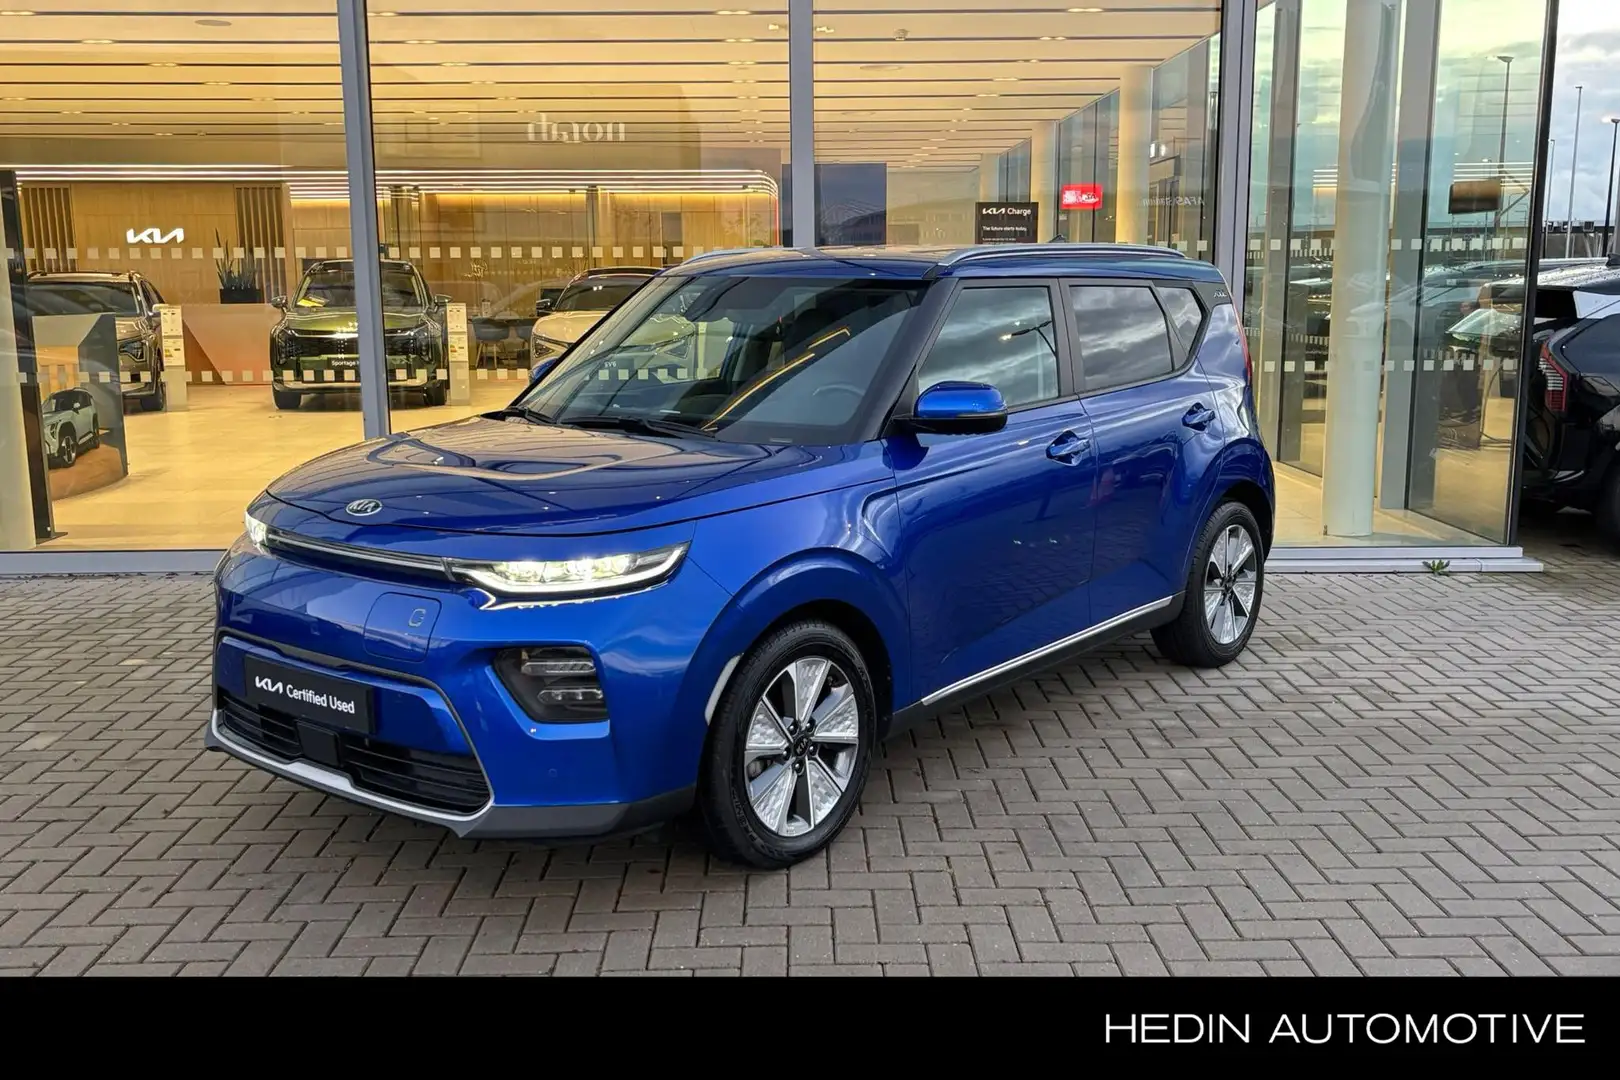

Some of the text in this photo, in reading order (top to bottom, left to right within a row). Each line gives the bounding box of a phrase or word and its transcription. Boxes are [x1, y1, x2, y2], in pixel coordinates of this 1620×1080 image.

[982, 207, 1032, 217] KIA Charge
[126, 227, 185, 244] KIA
[255, 675, 355, 714] KIA Certified Used
